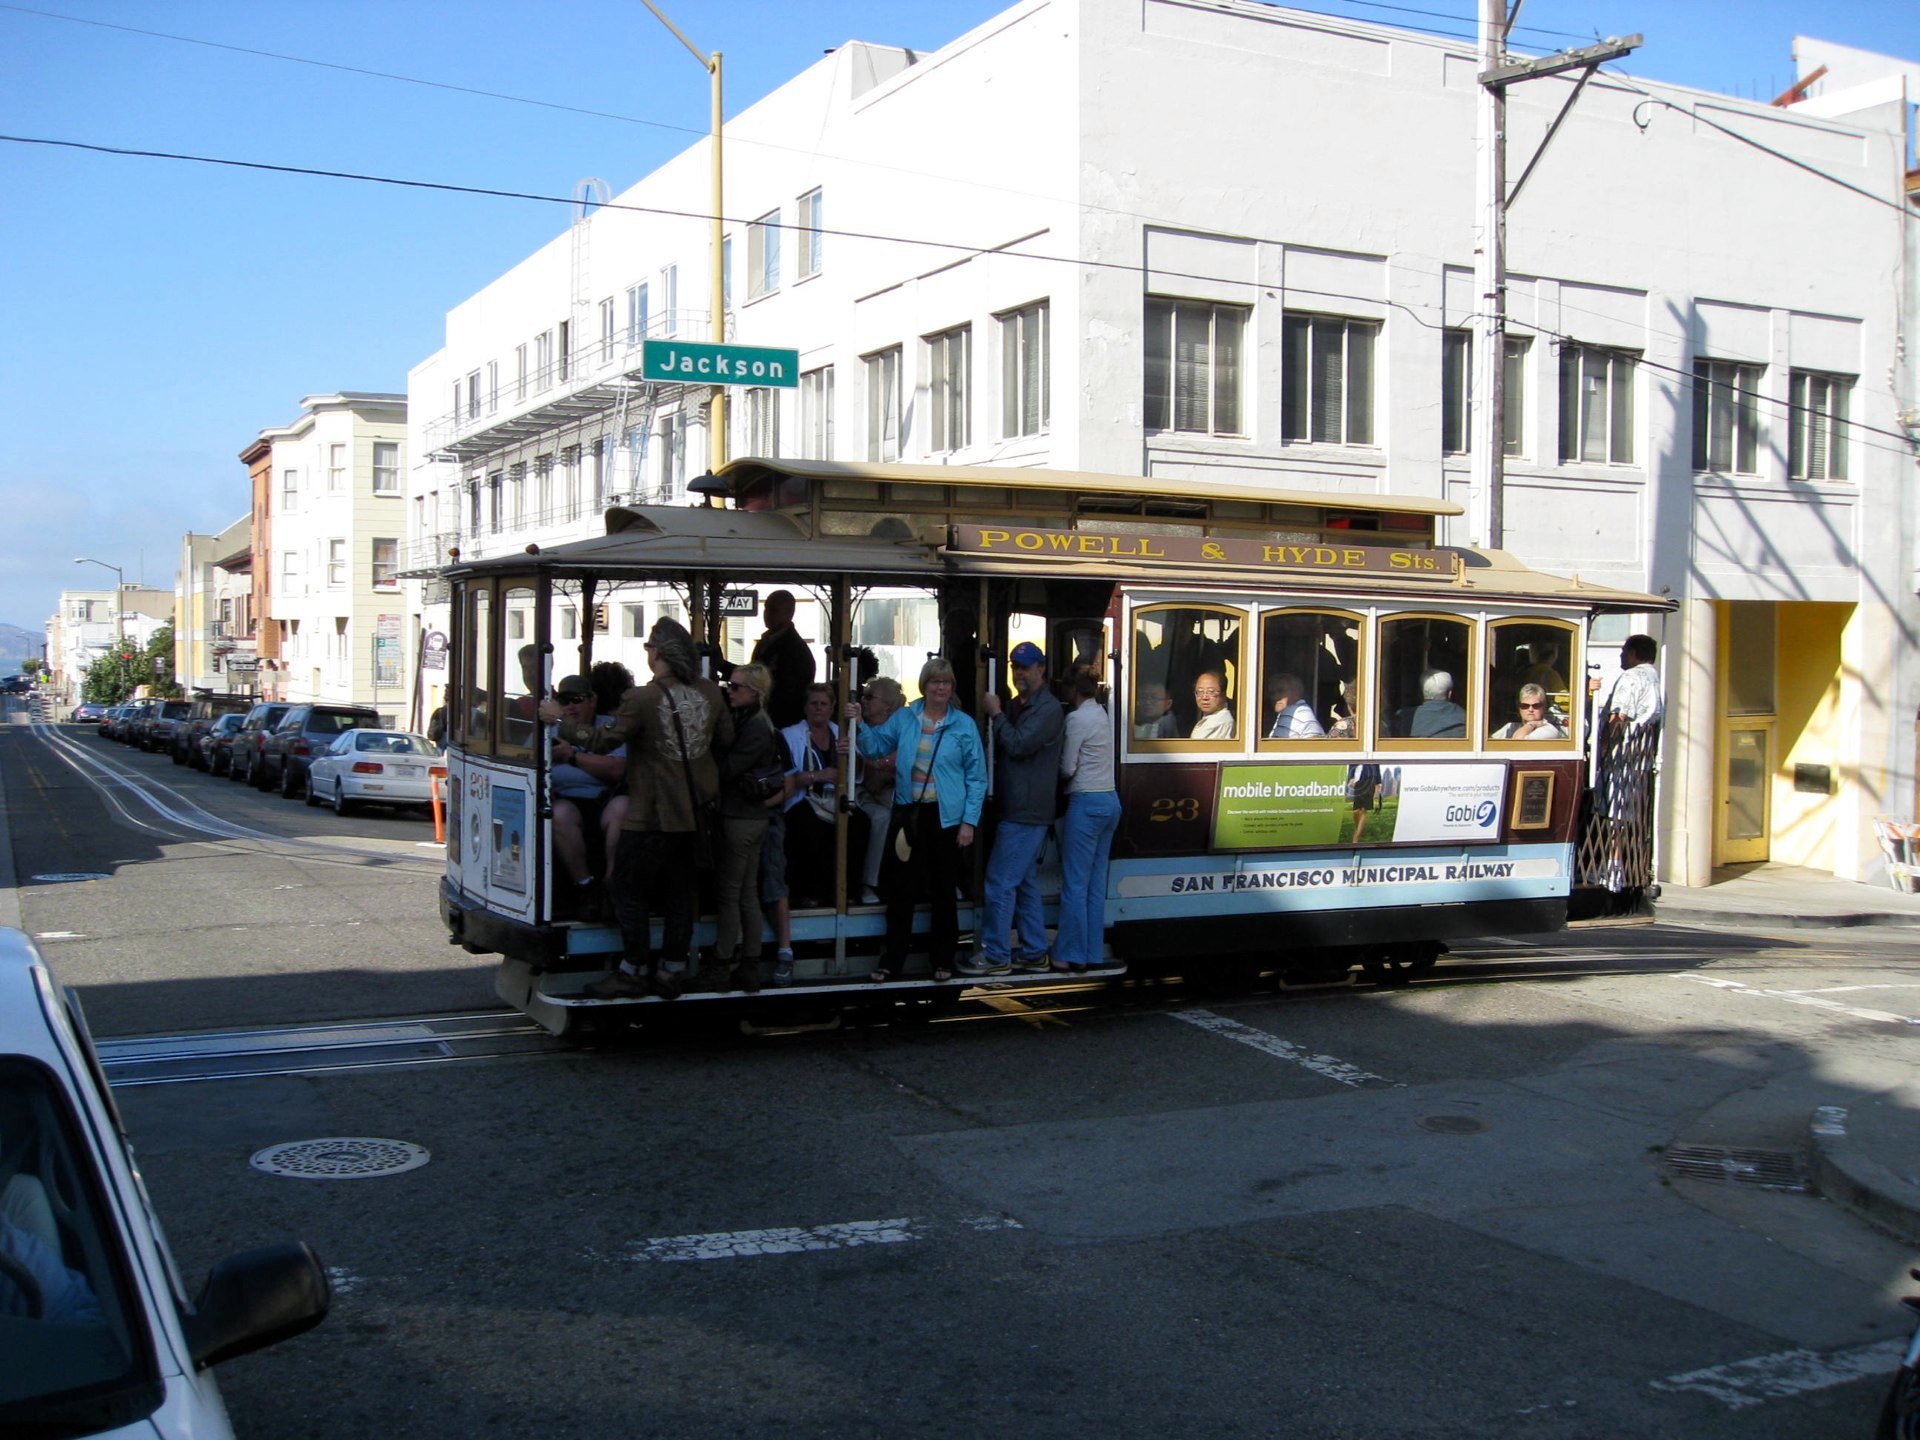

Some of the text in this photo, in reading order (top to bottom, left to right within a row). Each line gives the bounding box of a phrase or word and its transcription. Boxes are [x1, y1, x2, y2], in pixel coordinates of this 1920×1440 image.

[659, 350, 784, 379] Jackson
[978, 529, 1166, 558] POWELL
[1200, 542, 1228, 561] &
[1262, 545, 1366, 567] HYDE
[728, 596, 750, 609] WAY
[1223, 780, 1347, 799] mobile broadband
[1150, 797, 1200, 822] 23
[1446, 805, 1476, 822] Gobi
[1171, 863, 1515, 893] SAN FRANCISCO MUNICIPAL RAILWAY
